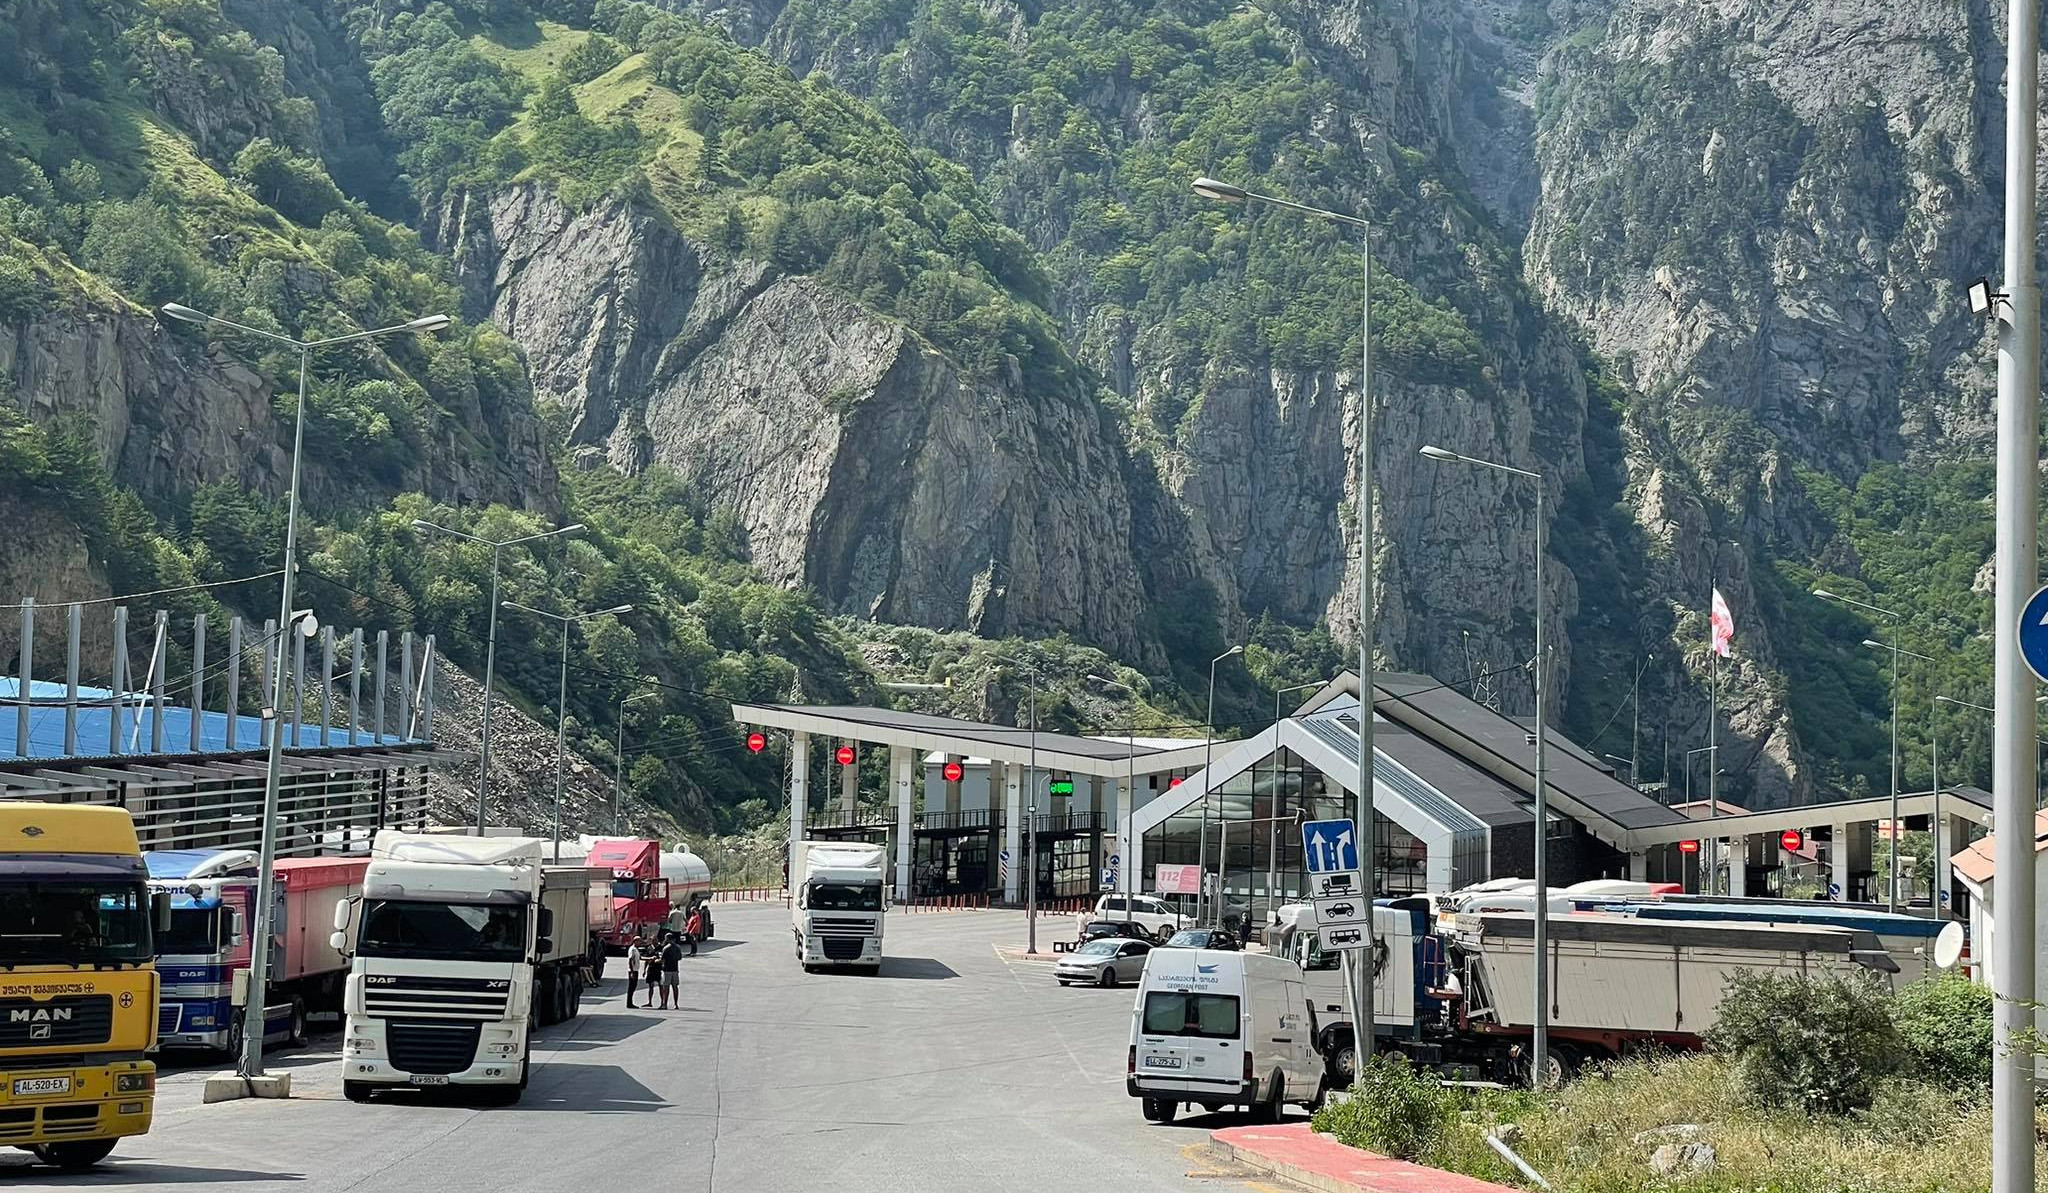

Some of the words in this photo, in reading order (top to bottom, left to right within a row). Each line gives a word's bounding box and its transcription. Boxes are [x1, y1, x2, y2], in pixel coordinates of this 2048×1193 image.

[1102, 869, 1111, 882] P
[1160, 871, 1179, 881] 112
[10, 1008, 72, 1022] MAN
[22, 1079, 64, 1091] AL-520-EX
